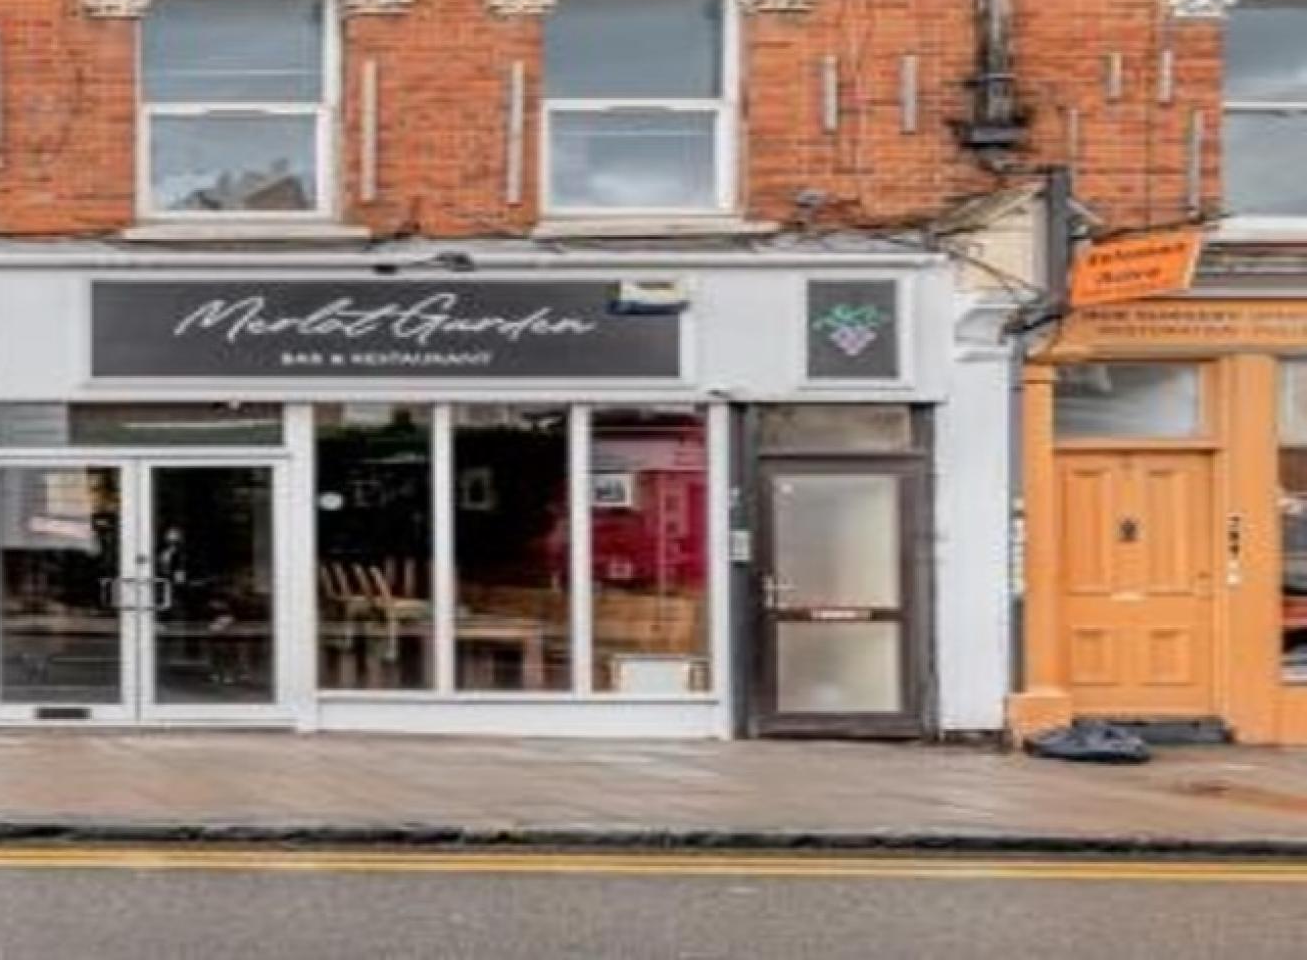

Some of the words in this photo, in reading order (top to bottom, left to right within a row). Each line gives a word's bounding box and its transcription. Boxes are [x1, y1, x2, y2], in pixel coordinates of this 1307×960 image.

[173, 295, 400, 342] Merlot
[388, 292, 597, 345] Garden
[282, 351, 323, 366] BAR
[350, 351, 492, 367] RESTAURANT
